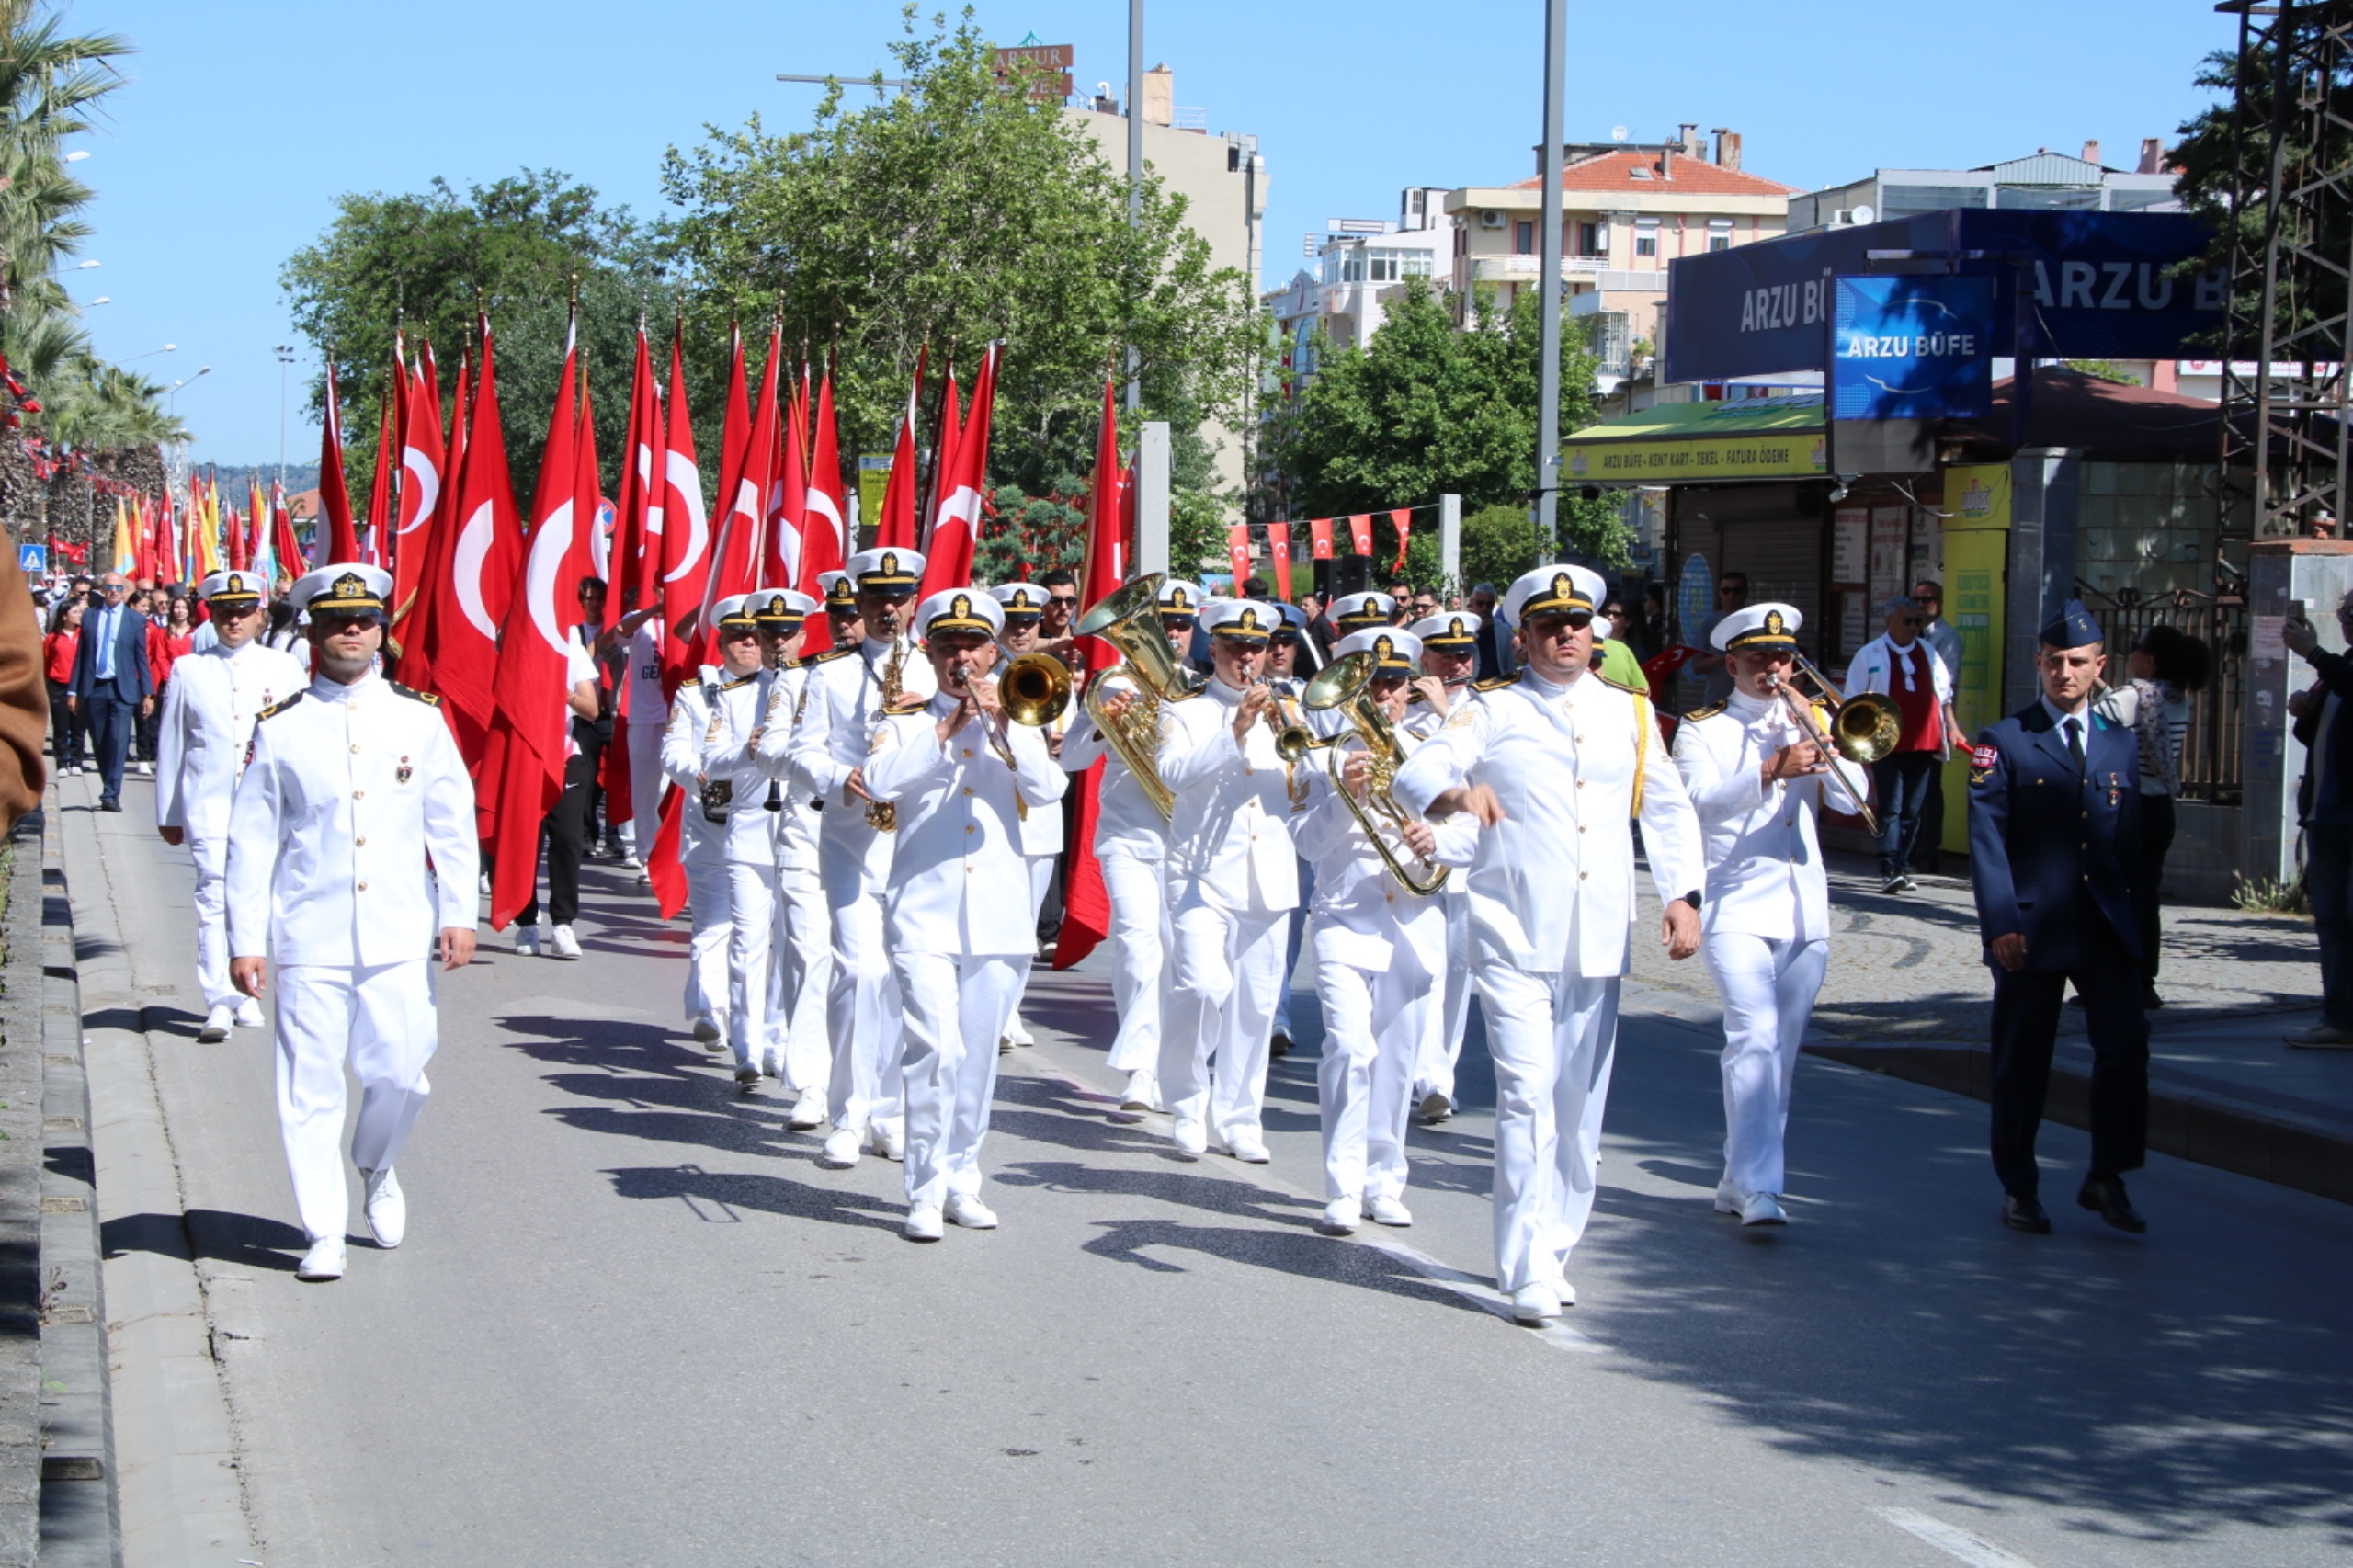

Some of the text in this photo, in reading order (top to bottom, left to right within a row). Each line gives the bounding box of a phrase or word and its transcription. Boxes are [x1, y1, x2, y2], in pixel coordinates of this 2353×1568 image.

[2033, 260, 2174, 310] ARZU
[1741, 283, 1798, 332] ARZU
[1847, 331, 1975, 358] ARZU BÜFE
[1603, 455, 1622, 468] ARZU
[1624, 450, 1642, 468] BÜFE
[1649, 453, 1668, 467] KENT
[1670, 452, 1689, 466] KART
[1697, 451, 1719, 466] TEKEL
[1727, 449, 1757, 464] FATURA
[1760, 445, 1790, 463] ÖDEME
